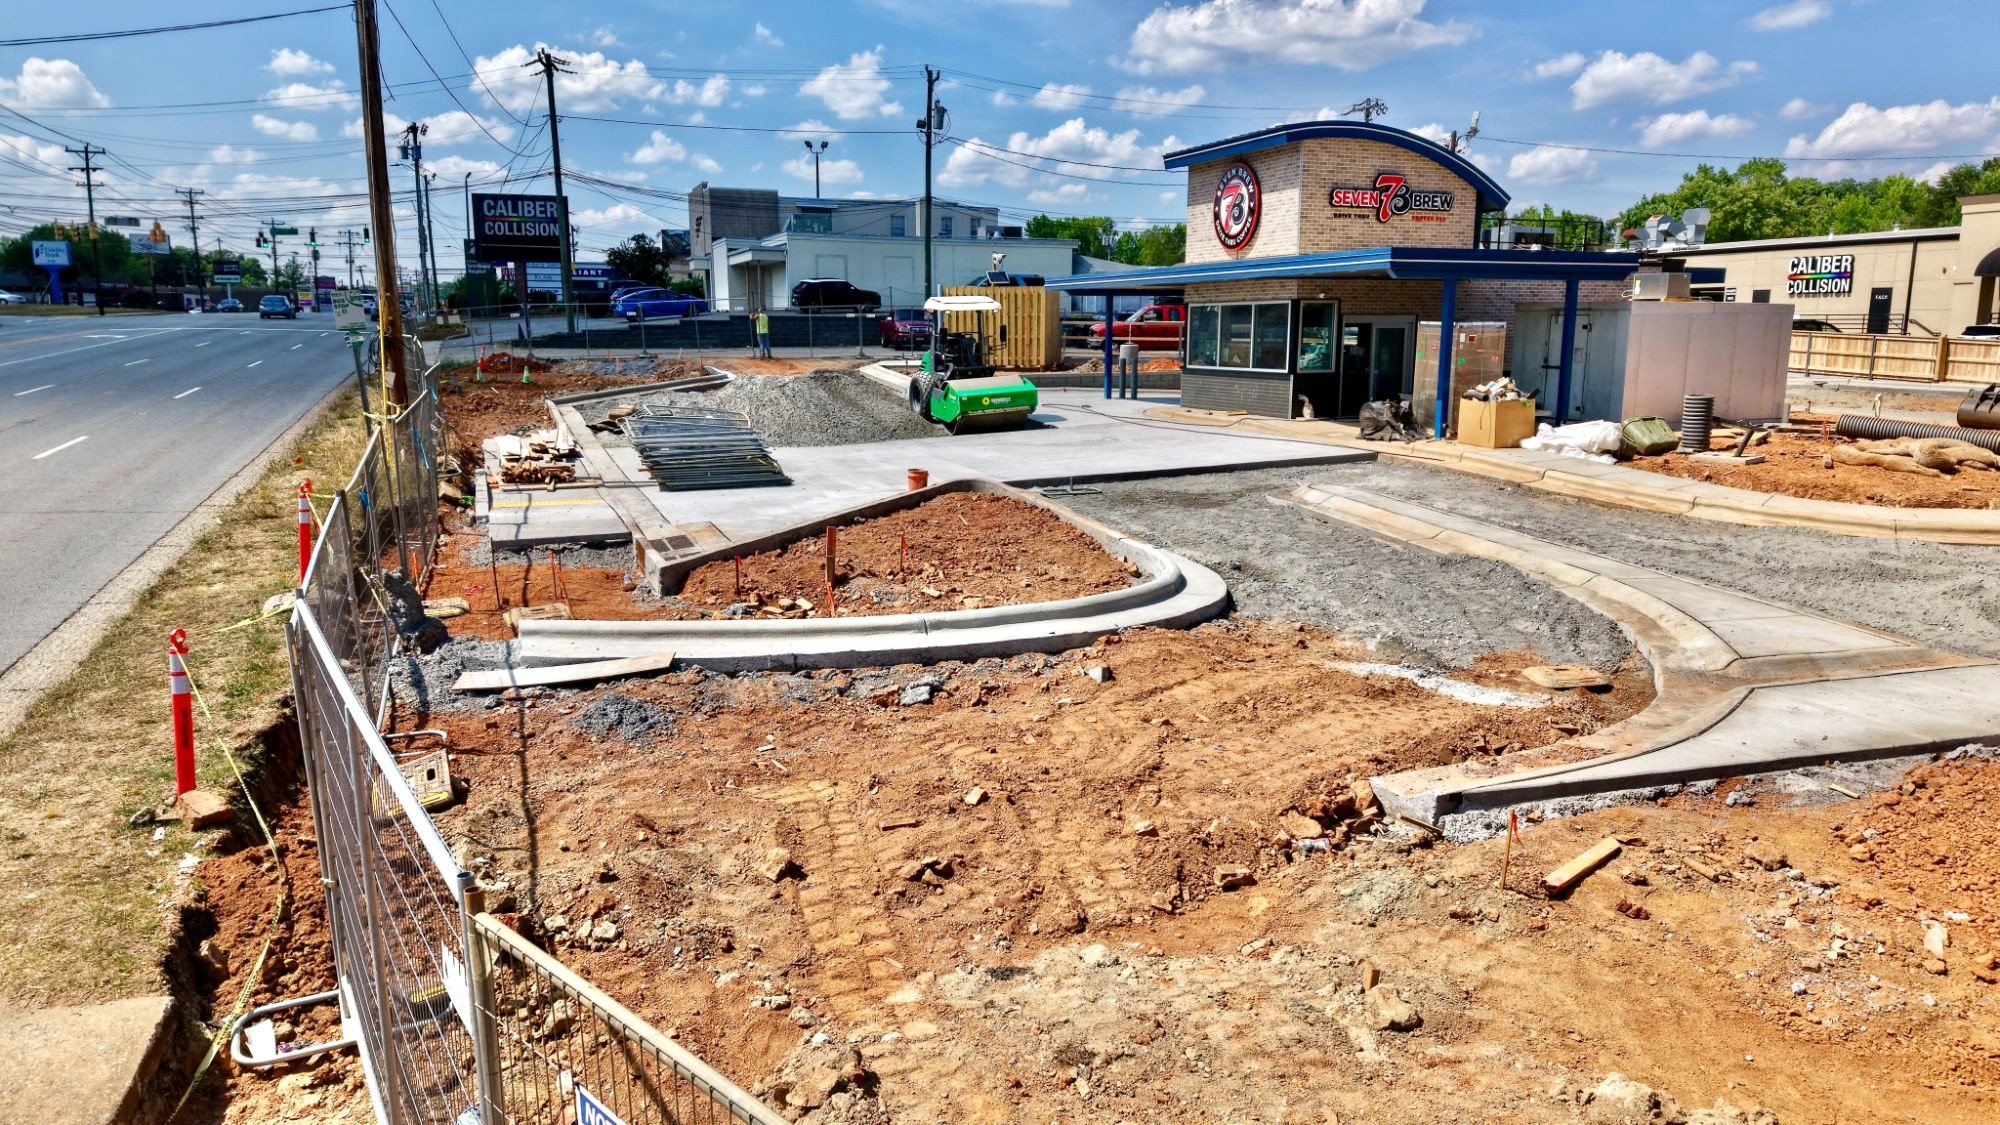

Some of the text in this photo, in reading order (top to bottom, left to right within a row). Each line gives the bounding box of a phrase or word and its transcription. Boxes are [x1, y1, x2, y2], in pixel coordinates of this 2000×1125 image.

[1238, 168, 1255, 194] BREW
[483, 199, 558, 217] CALIBER
[1333, 189, 1379, 207] SEVEN
[1412, 192, 1453, 211] BREW
[484, 221, 560, 237] COLLISION
[572, 268, 603, 276] LIANT
[1789, 256, 1852, 273] CALIBER
[1787, 279, 1850, 294] COLLISION
[585, 1101, 613, 1125] NO
